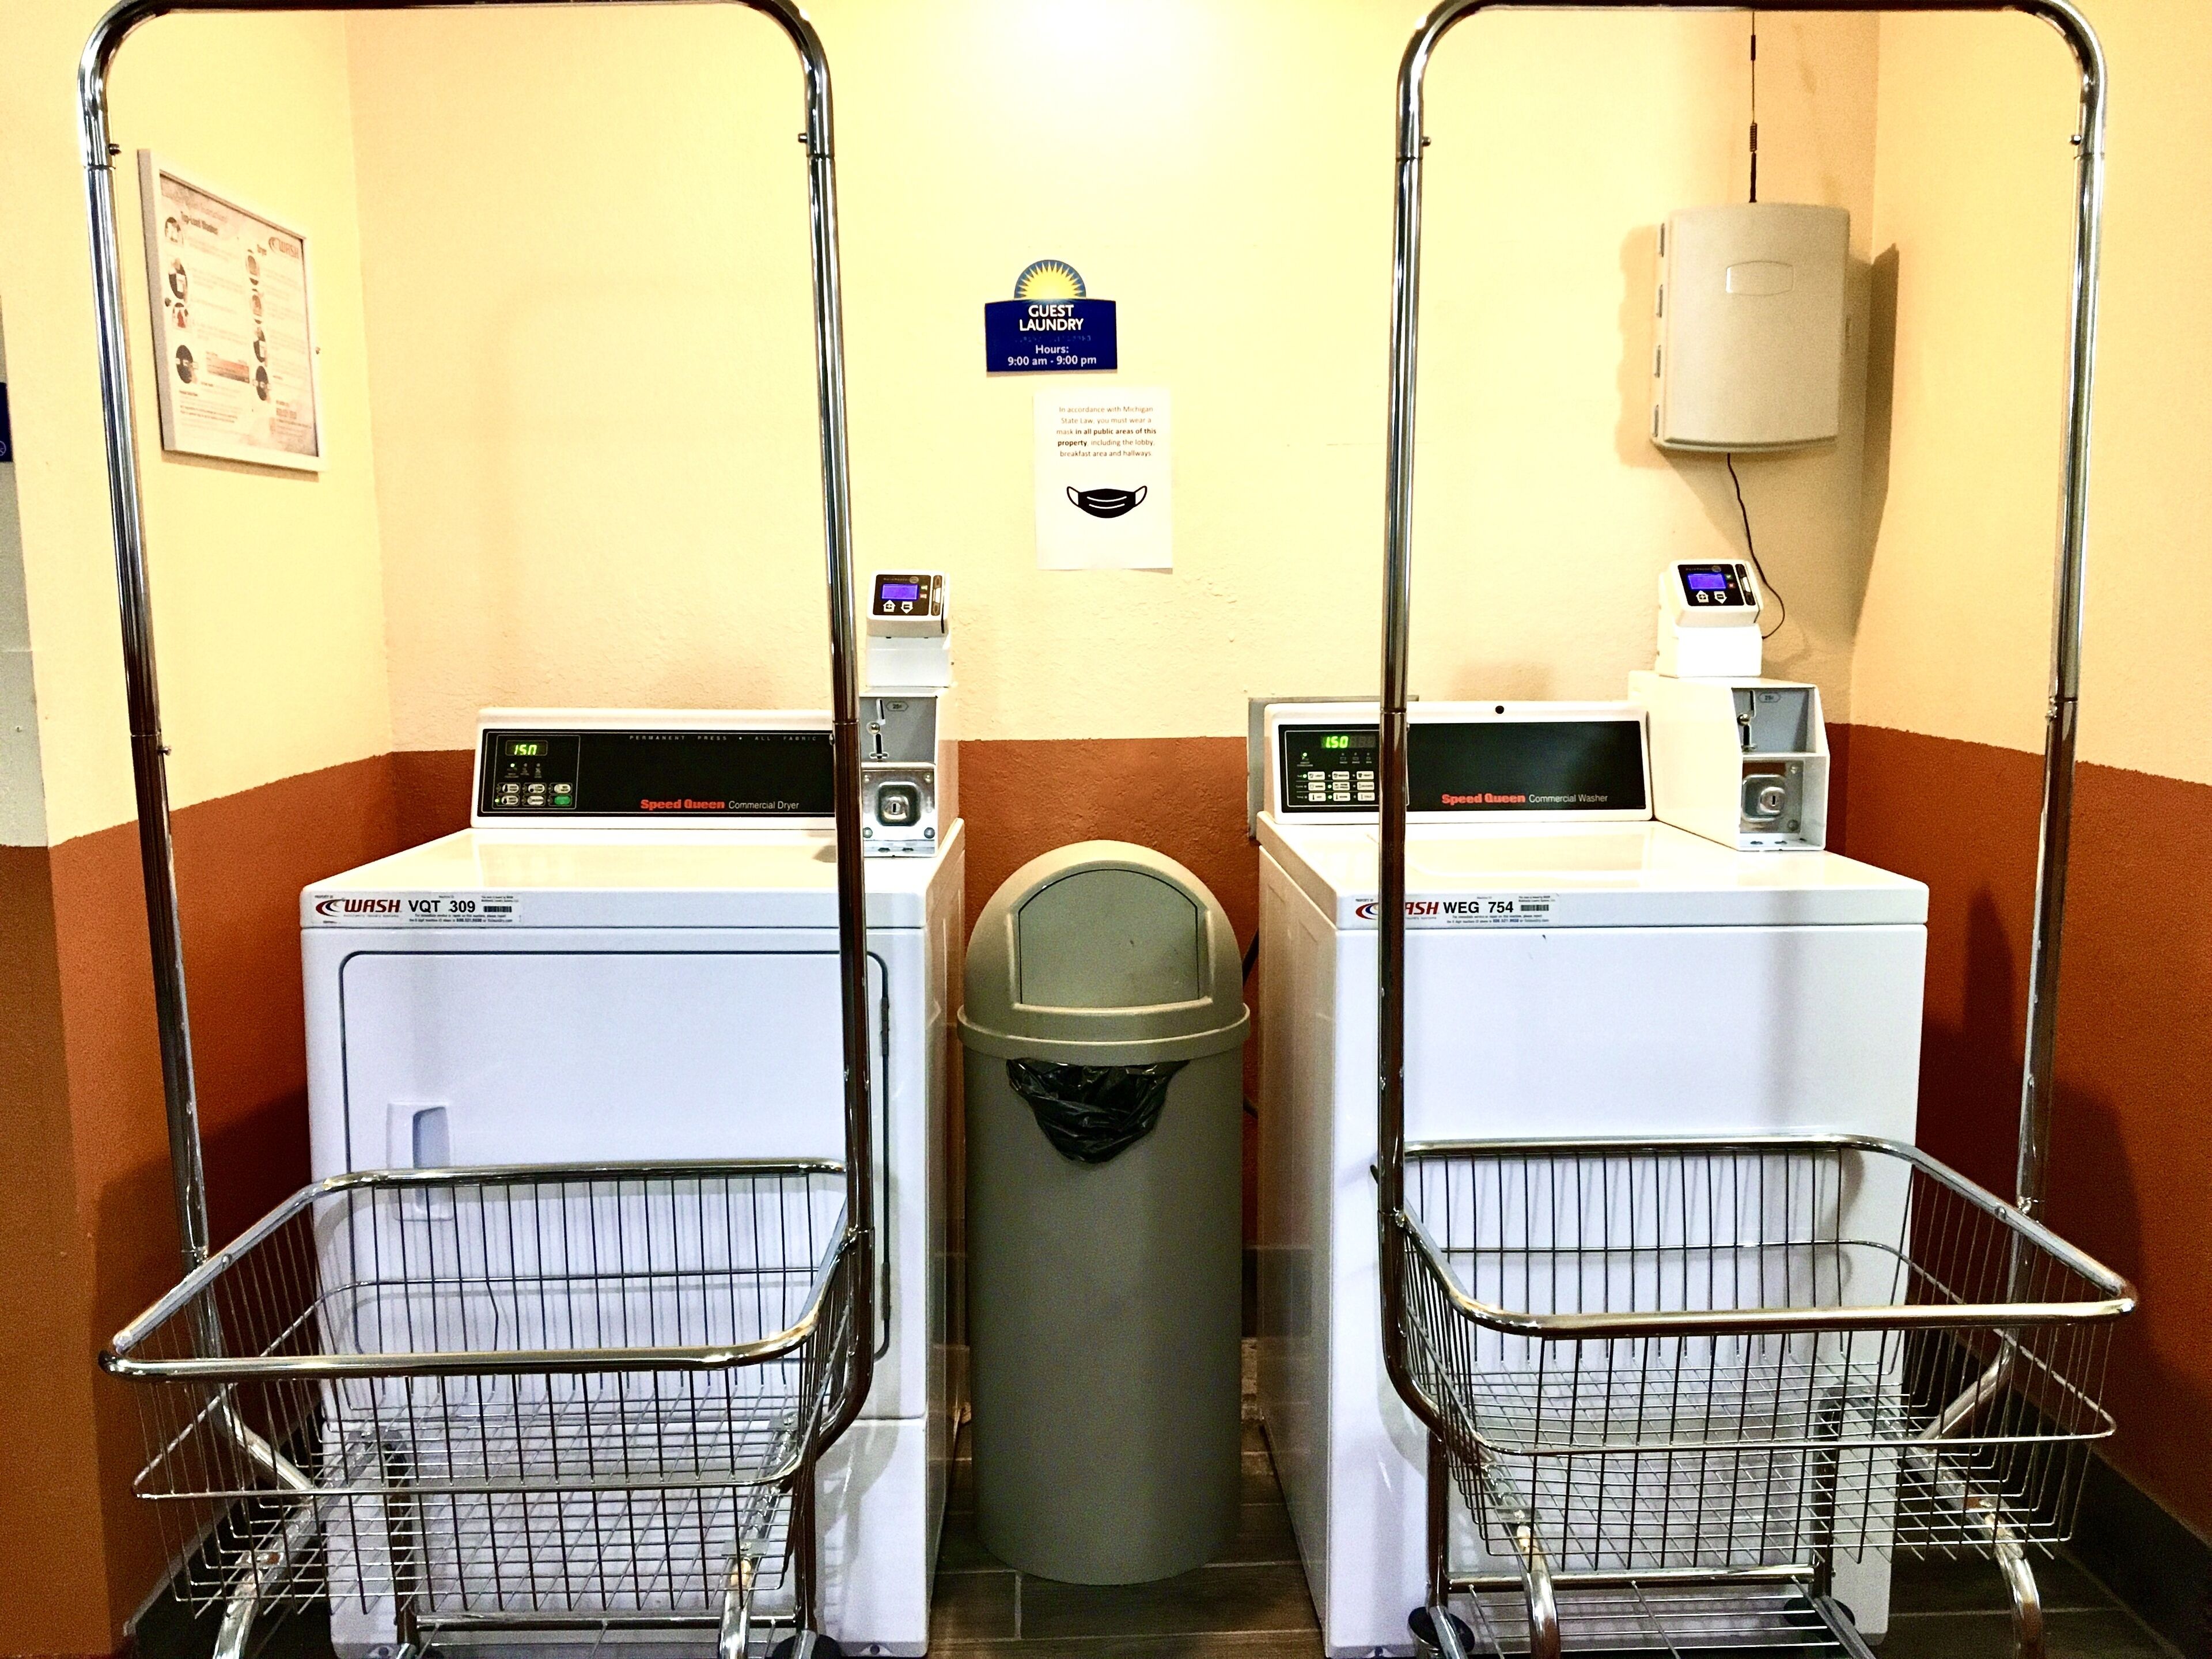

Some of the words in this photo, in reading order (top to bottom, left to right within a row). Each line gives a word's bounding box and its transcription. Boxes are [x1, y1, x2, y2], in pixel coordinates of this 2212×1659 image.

[1028, 305, 1074, 317] GUEST
[1019, 319, 1084, 331] LAUNDRY
[1035, 345, 1069, 354] Hours:
[1008, 357, 1029, 366] 9:00
[1056, 355, 1078, 365] 9:00
[1081, 357, 1096, 367] pm
[641, 800, 681, 810] Speed
[684, 799, 725, 809] Queen
[729, 801, 775, 809] Commercial
[777, 801, 799, 810] Dryer
[1442, 793, 1482, 805] Speed
[1484, 793, 1526, 803] Queen
[1528, 794, 1576, 803] Commercial
[1578, 794, 1608, 802] Washer
[344, 899, 401, 912] WASH
[408, 900, 441, 914] VQT
[450, 900, 475, 913] 309
[1405, 902, 1439, 915] ASH
[1443, 901, 1479, 914] WEG
[1488, 901, 1514, 914] 754
